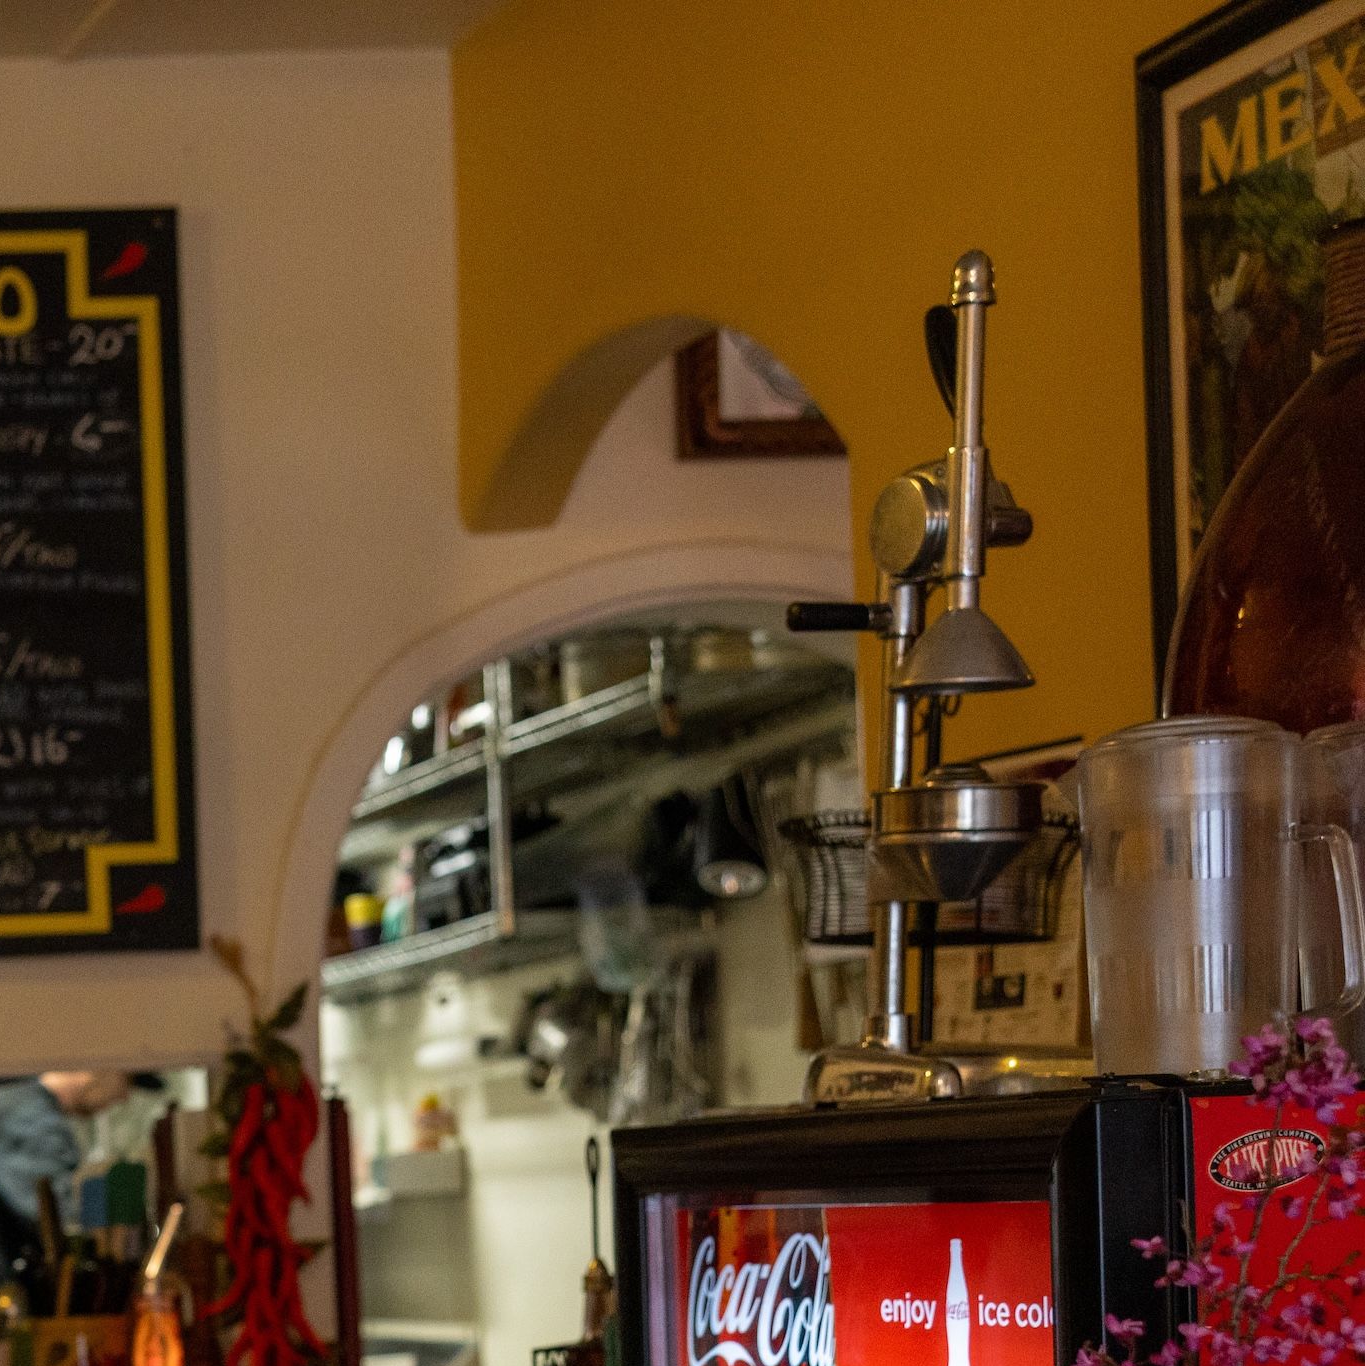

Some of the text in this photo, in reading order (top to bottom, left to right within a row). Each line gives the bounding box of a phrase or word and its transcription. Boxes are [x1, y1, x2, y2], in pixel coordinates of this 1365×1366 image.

[1214, 1129, 1315, 1164] THE PIKE BREWIN COMPANY
[880, 1295, 938, 1331] enjoy
[977, 1294, 1010, 1327] ice
